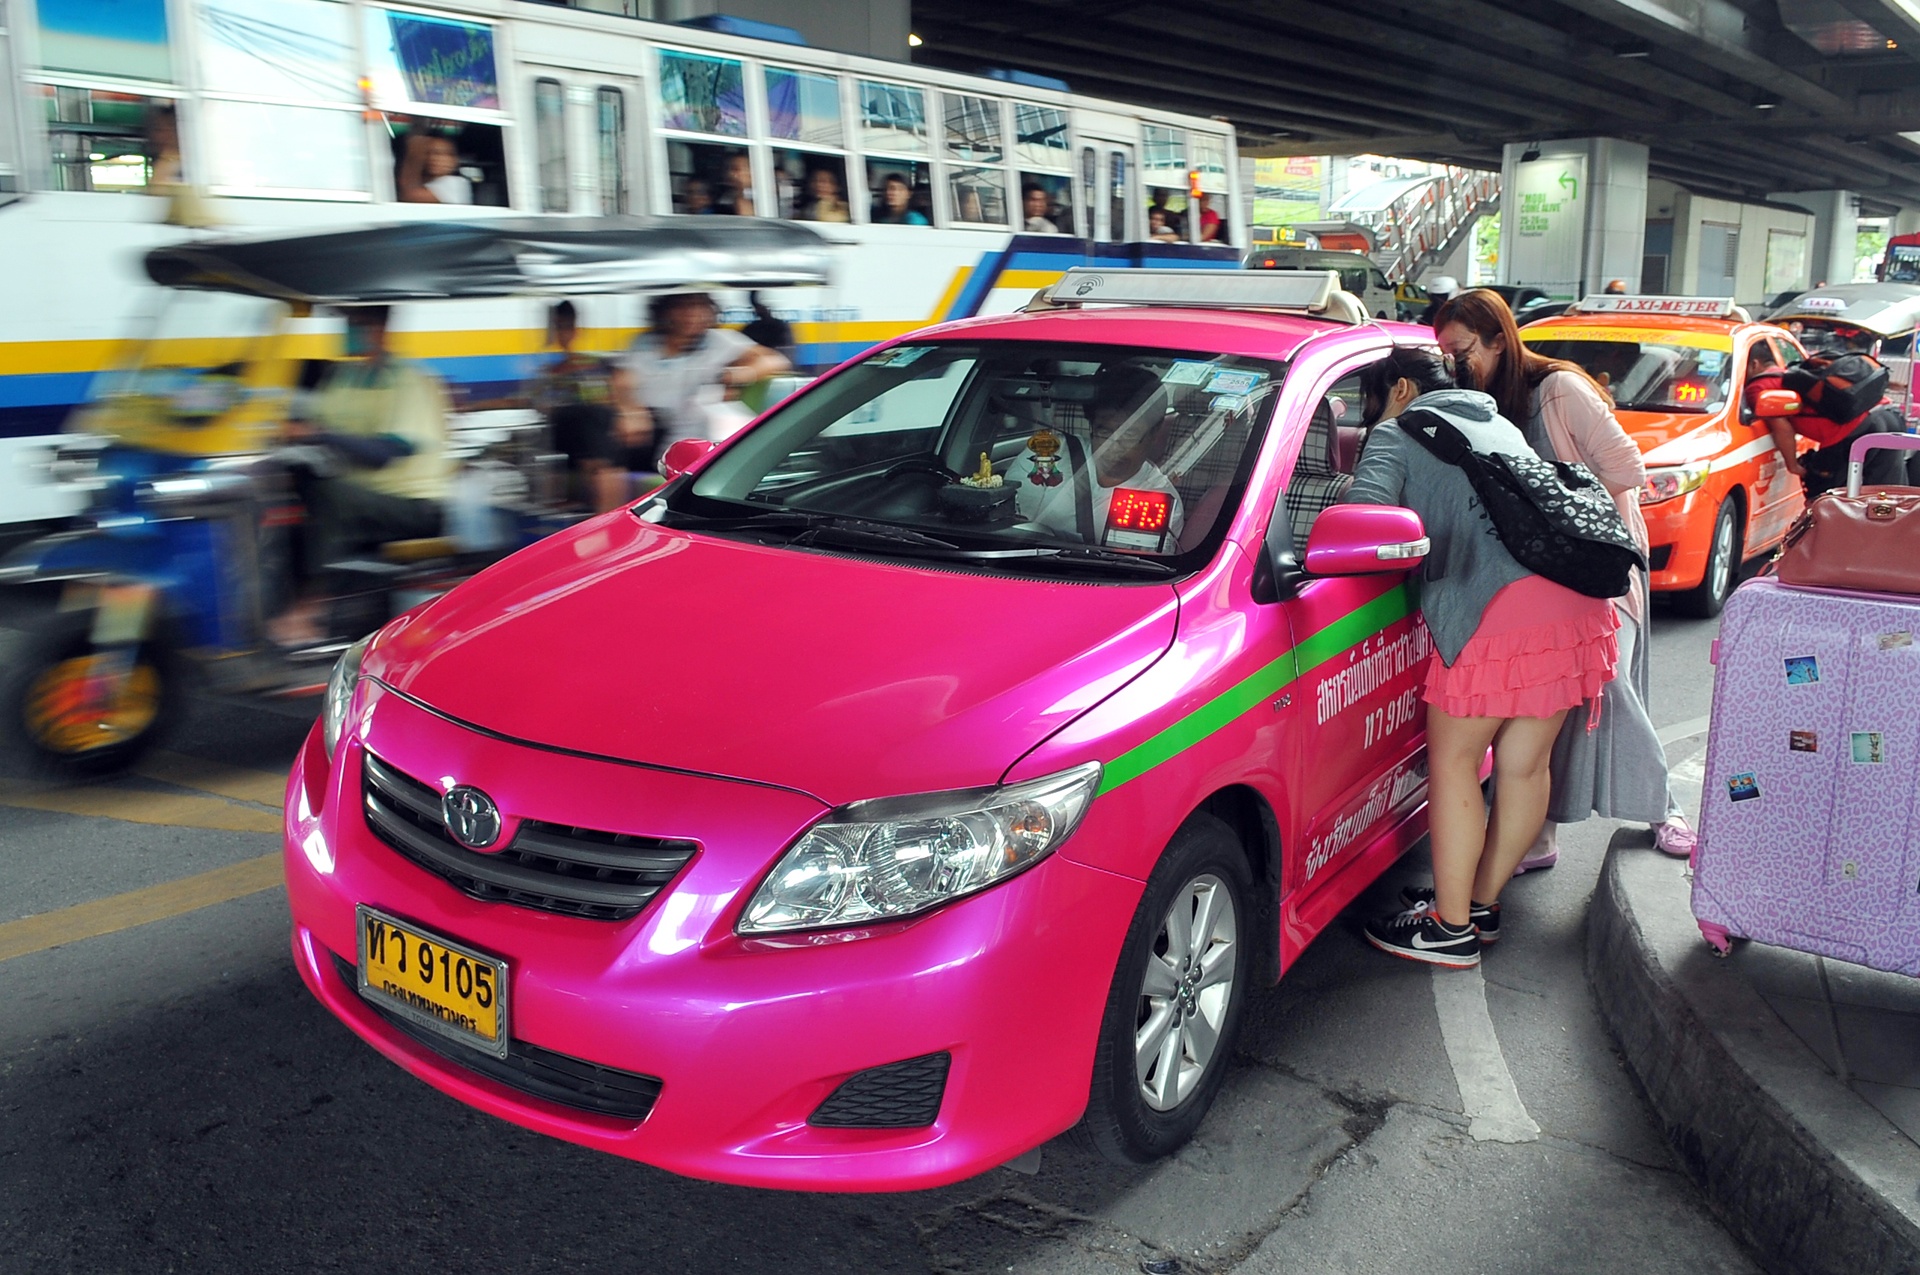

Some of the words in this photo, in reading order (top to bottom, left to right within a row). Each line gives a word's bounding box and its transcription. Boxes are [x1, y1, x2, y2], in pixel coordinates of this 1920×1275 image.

[1615, 299, 1720, 312] TAXI-METER
[1809, 299, 1835, 308] TAXI
[1385, 685, 1418, 736] 9105
[418, 942, 493, 1009] 9105
[382, 979, 477, 1031] กรงเทพมหานคร
[411, 1013, 443, 1032] TOYOTA
